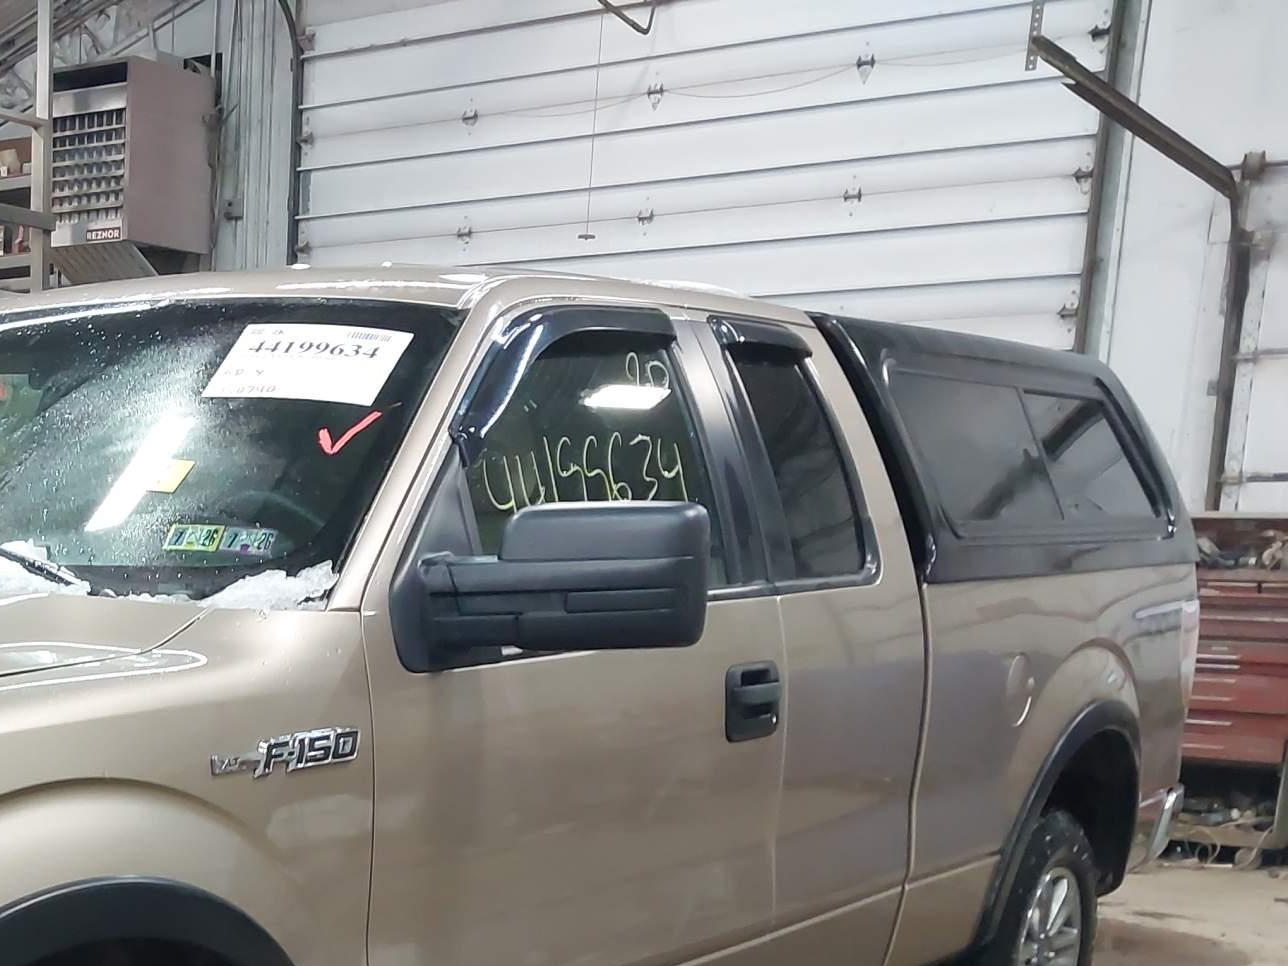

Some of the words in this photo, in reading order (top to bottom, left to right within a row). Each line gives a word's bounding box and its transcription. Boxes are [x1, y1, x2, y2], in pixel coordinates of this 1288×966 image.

[86, 229, 120, 240] REZNOR
[248, 340, 381, 359] 44199634
[201, 529, 218, 546] 26
[257, 532, 274, 550] 26
[254, 729, 360, 778] F-150
